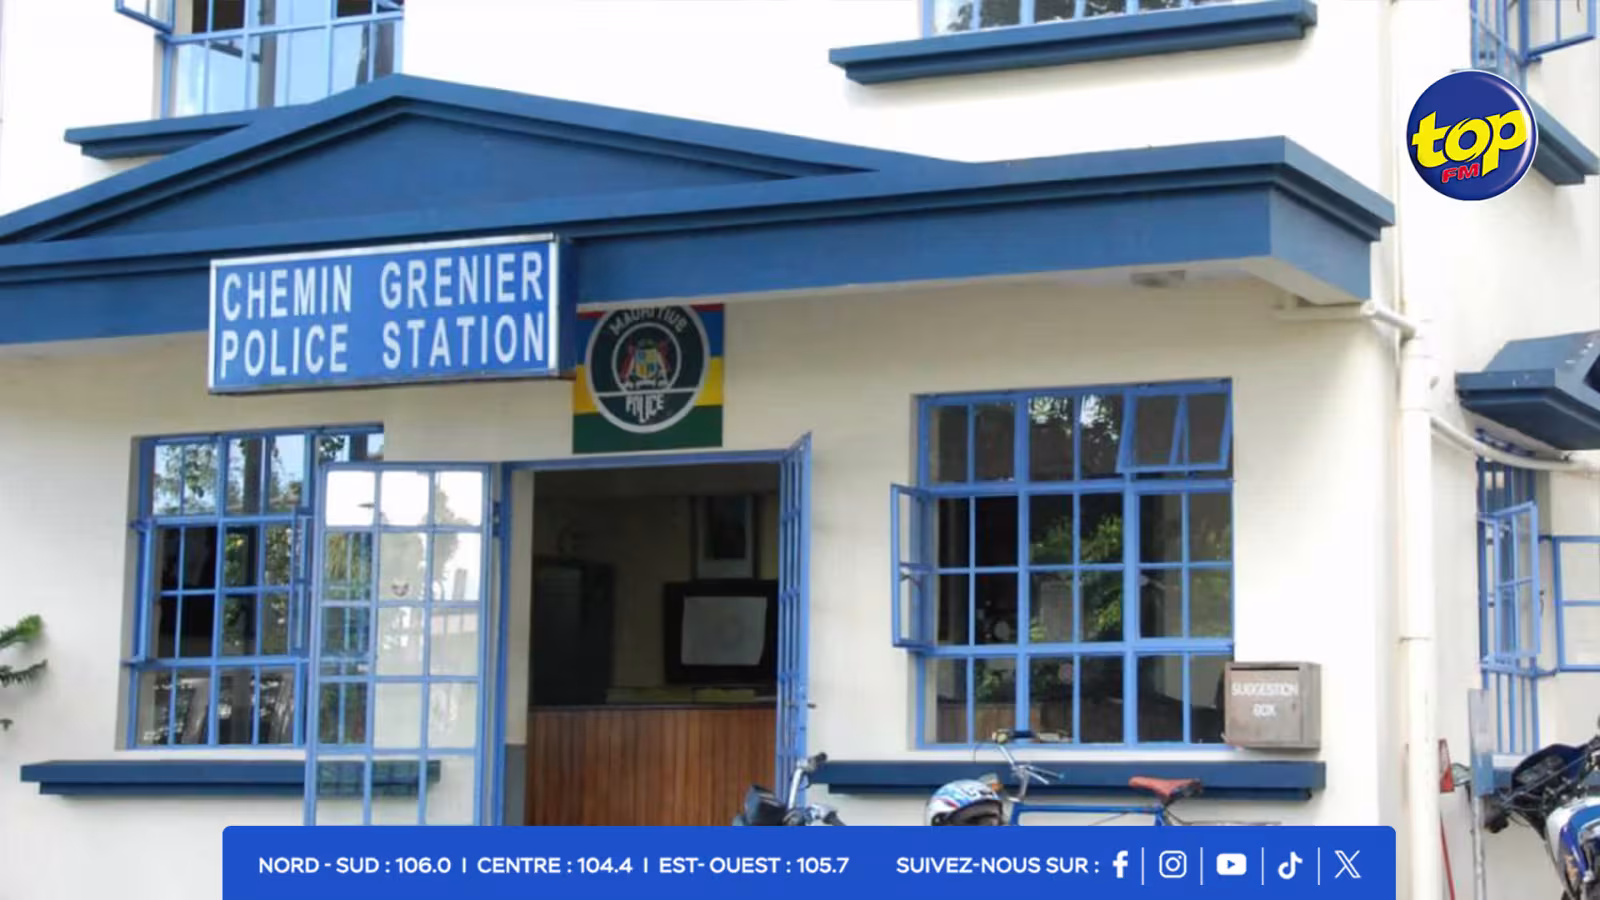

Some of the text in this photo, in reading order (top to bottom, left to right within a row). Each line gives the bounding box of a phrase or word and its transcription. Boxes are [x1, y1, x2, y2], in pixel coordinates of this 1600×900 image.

[222, 251, 544, 321] CHEMIN GRENIER
[220, 312, 544, 379] POLICE STATION
[625, 394, 665, 423] POLICE
[1231, 682, 1299, 697] SUGGESTION
[1253, 703, 1277, 717] BOX
